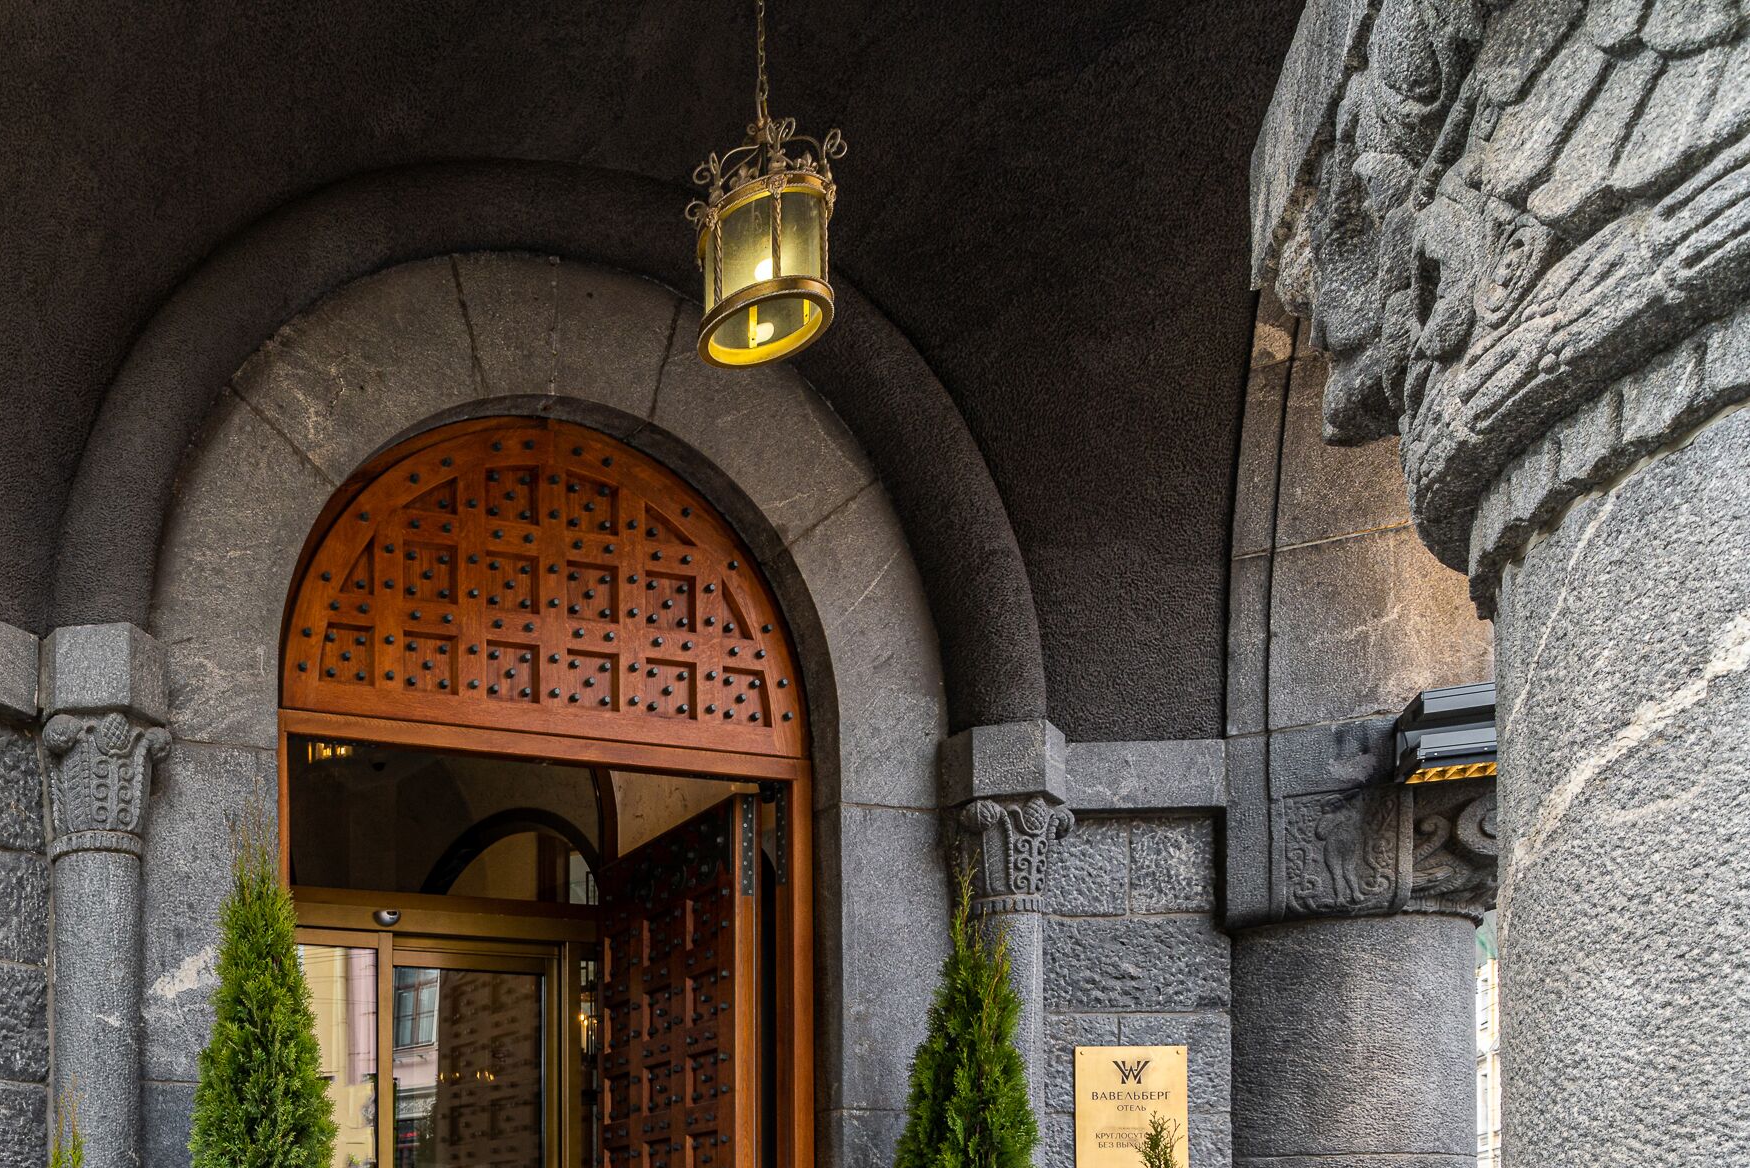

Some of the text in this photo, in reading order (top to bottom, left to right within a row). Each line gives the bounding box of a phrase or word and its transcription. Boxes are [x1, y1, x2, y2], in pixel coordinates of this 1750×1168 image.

[1091, 1091, 1171, 1101] ВАВЕЛЬБЕРГ
[1116, 1104, 1147, 1112] ОТЕЛЬ
[1098, 1141, 1115, 1149] БЕЗ
